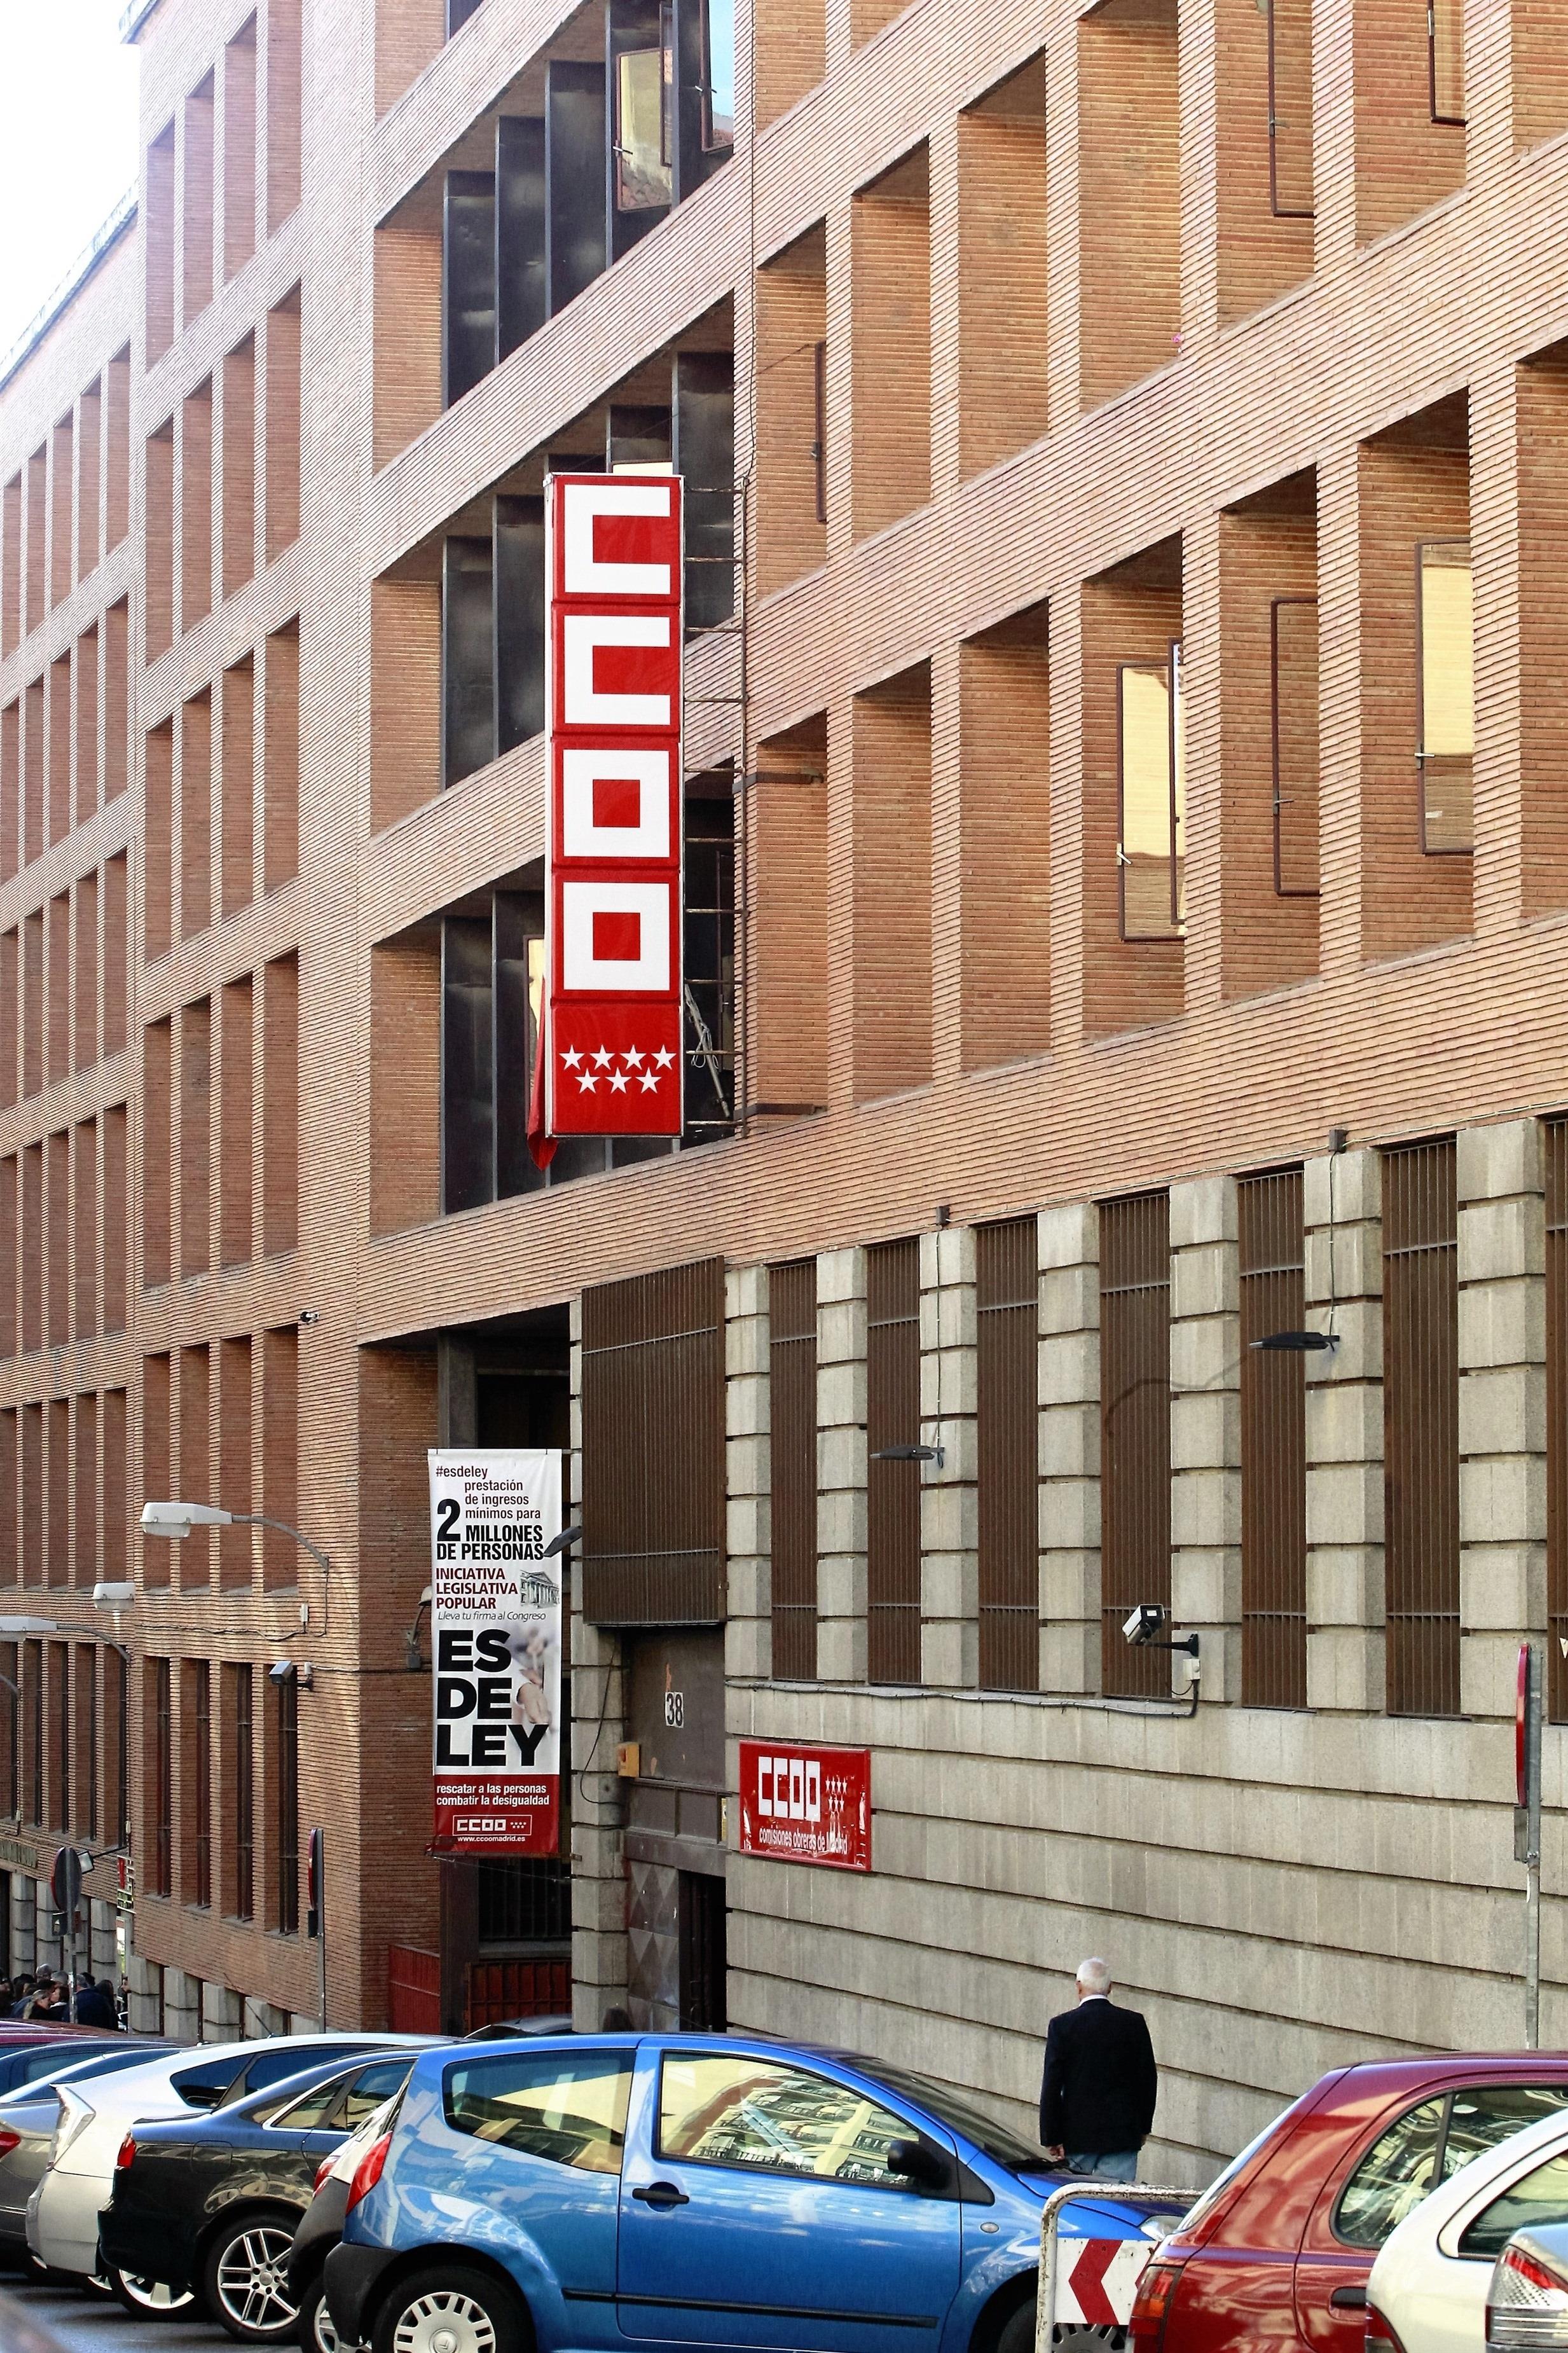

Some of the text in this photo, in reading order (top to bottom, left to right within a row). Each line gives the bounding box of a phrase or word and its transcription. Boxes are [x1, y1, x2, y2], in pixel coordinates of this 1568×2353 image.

[564, 484, 671, 991] CCOO
[436, 1466, 488, 1479] #esdeley
[464, 1479, 523, 1493] prestación
[465, 1494, 529, 1507] de ingresos
[437, 1498, 542, 1542] 2 MILLONES
[465, 1507, 541, 1521] mínimos para
[437, 1543, 544, 1561] DE PERSONAS
[436, 1568, 505, 1580] INICIATIVA
[436, 1582, 518, 1594] LEGISLATIVA
[436, 1597, 496, 1609] POPULAR
[437, 1611, 460, 1620] Lleva
[473, 1611, 497, 1620] firma
[498, 1611, 505, 1620] al
[507, 1611, 546, 1622] Congreso
[438, 1629, 512, 1673] ES
[437, 1677, 512, 1720] DE
[666, 1692, 684, 1726] 38
[436, 1724, 549, 1767] LEY
[437, 1783, 546, 1795] rescatar a las personas
[758, 1756, 821, 1822] CCOO
[436, 1795, 549, 1807] combatir la desigualdad
[457, 1819, 506, 1832] CCOO
[759, 1826, 792, 1847] comisiones
[793, 1828, 816, 1850] obreras
[817, 1831, 825, 1851] de
